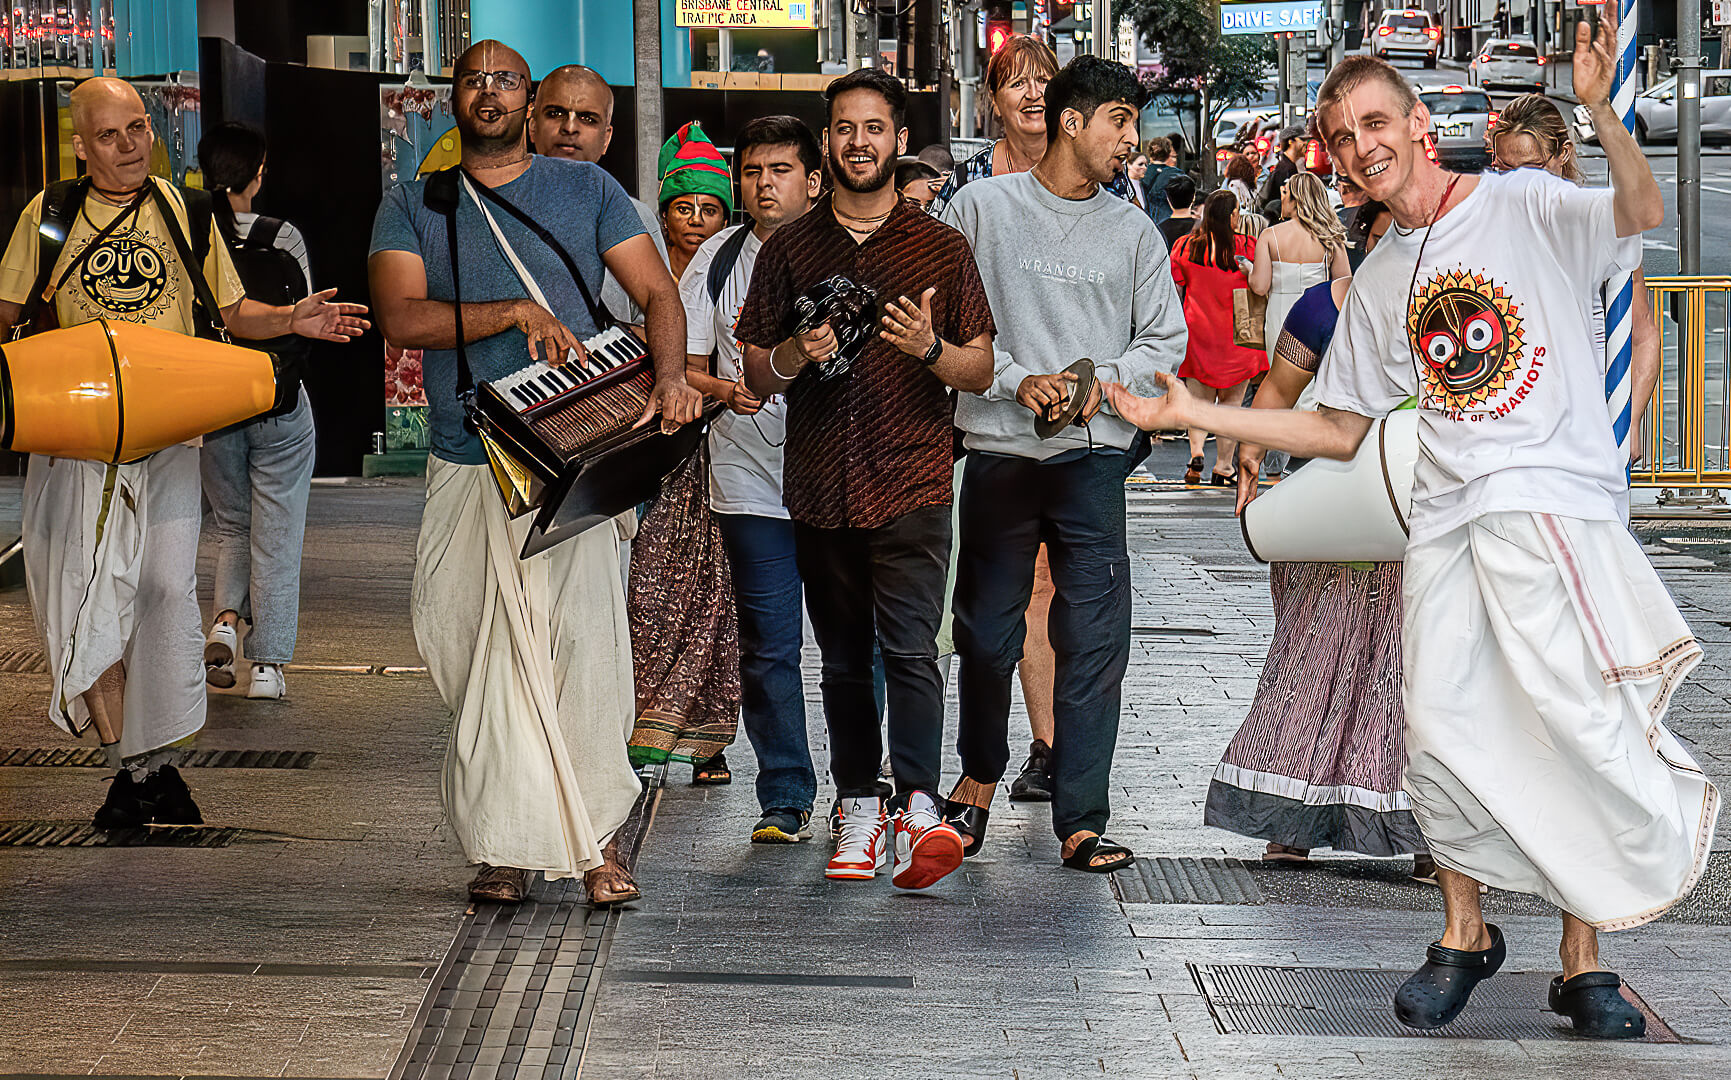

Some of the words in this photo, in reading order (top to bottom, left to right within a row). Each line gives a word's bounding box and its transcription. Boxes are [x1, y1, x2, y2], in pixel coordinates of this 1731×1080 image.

[682, 0, 731, 10] BRISBANE
[737, 0, 783, 11] CENTRAL
[682, 12, 725, 24] TRAFFIC
[729, 13, 757, 24] AREA
[1222, 10, 1273, 29] DRIVE
[1019, 258, 1105, 285] WRANGLER
[1470, 414, 1484, 422] OF
[1489, 346, 1546, 420] CHARIOTS
